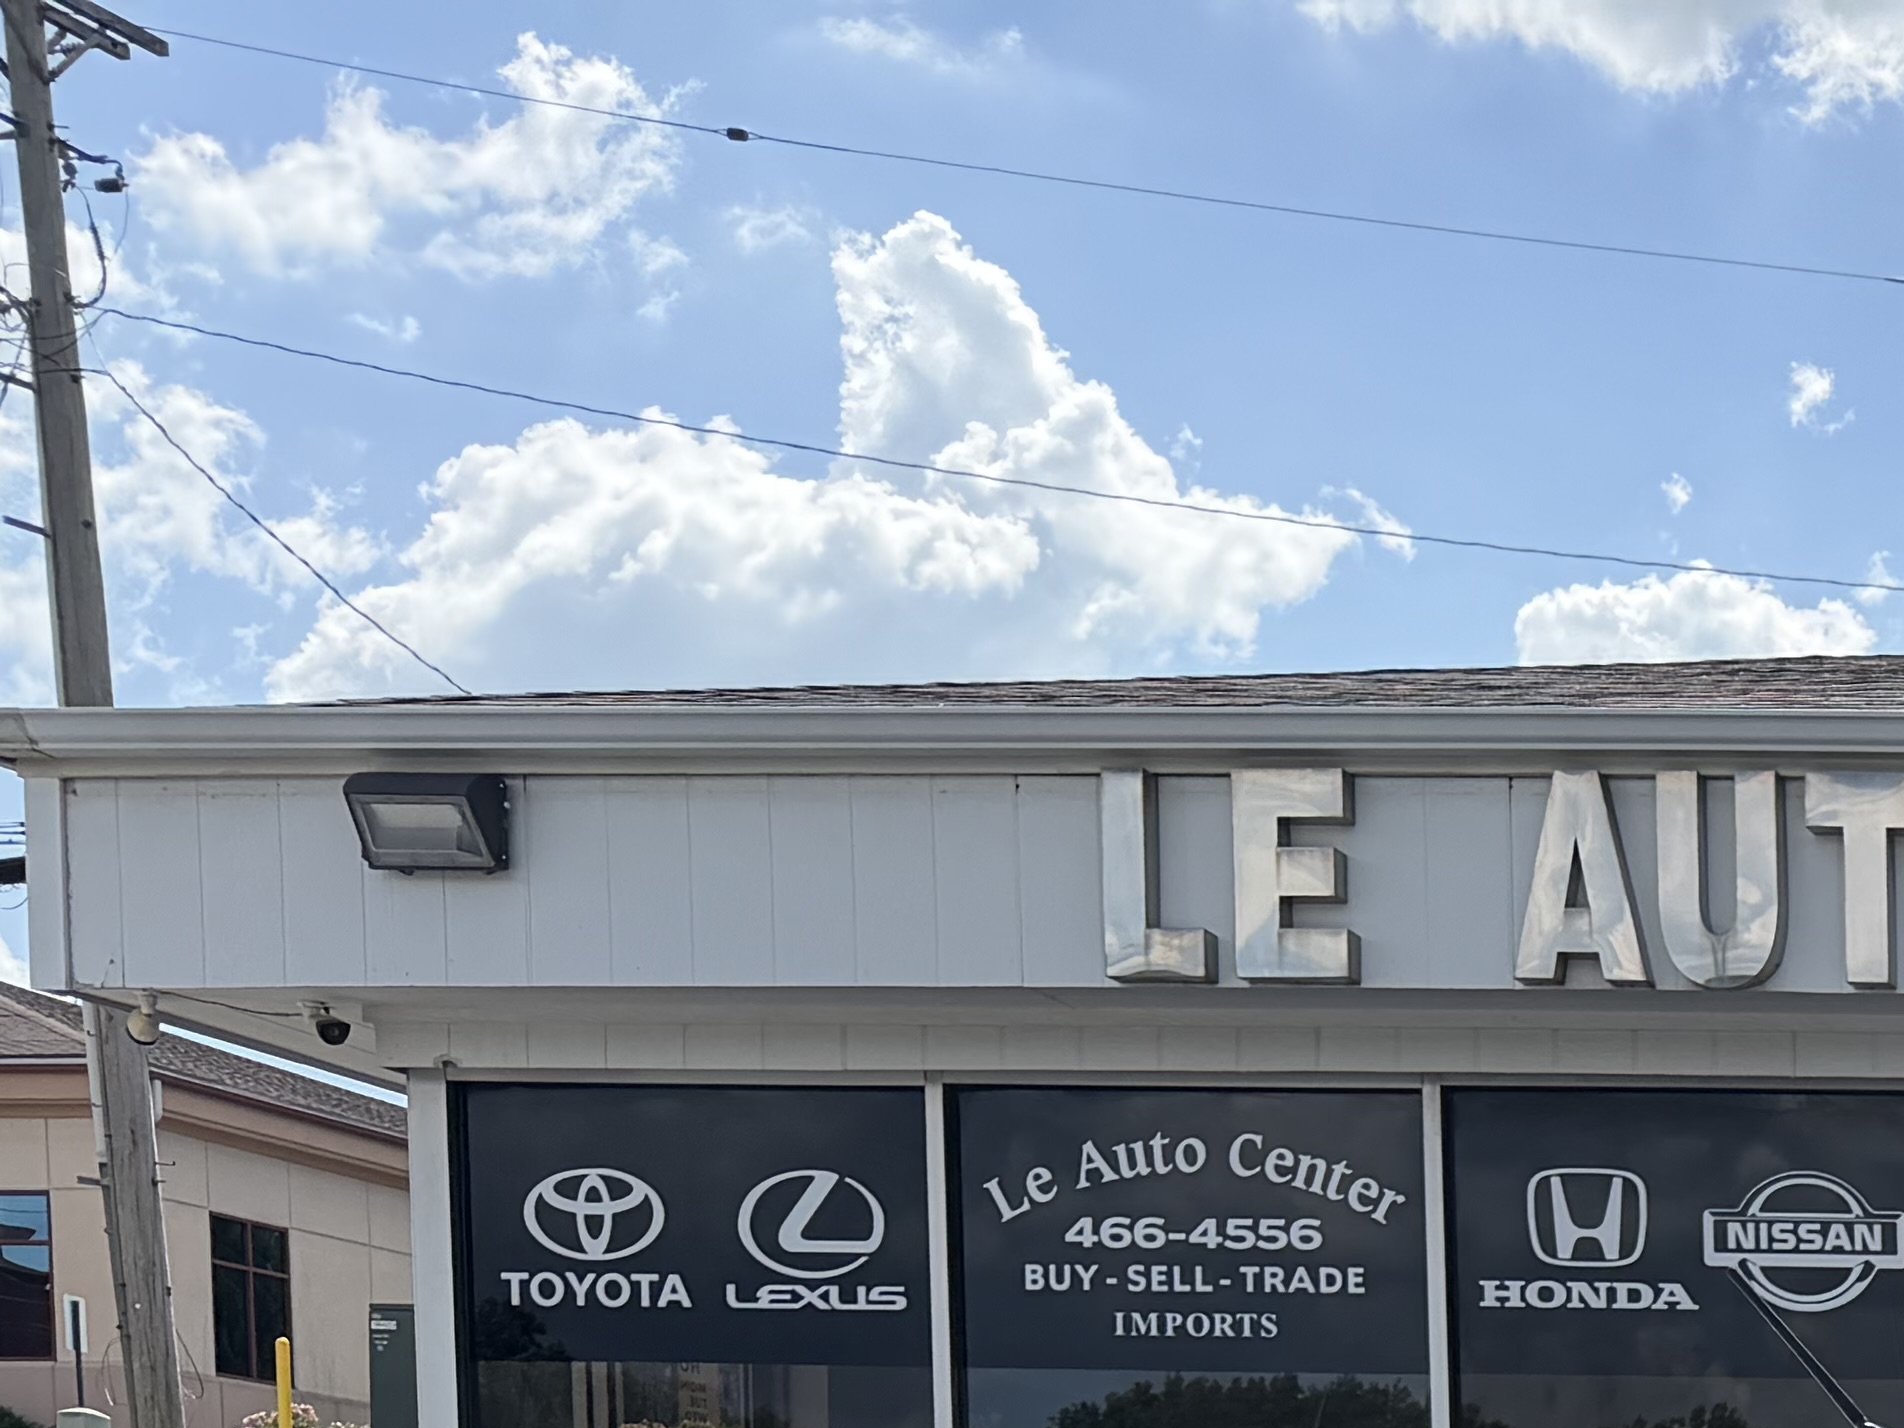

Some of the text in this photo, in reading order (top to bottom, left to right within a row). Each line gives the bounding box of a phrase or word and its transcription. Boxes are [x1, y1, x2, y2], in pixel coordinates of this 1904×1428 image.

[1101, 768, 1360, 986] LE
[983, 1131, 1407, 1225] Le Auto Center
[1064, 1216, 1324, 1251] 466-4556
[1727, 1221, 1884, 1253] NISSAN
[501, 1272, 692, 1308] TOYOTA
[1024, 1264, 1099, 1291] BUY
[1127, 1264, 1214, 1293] SELL
[1239, 1266, 1365, 1294] TRADE
[1478, 1279, 1699, 1311] HONDA
[726, 1284, 907, 1311] LEXUS
[1114, 1311, 1279, 1338] IMPORTS
